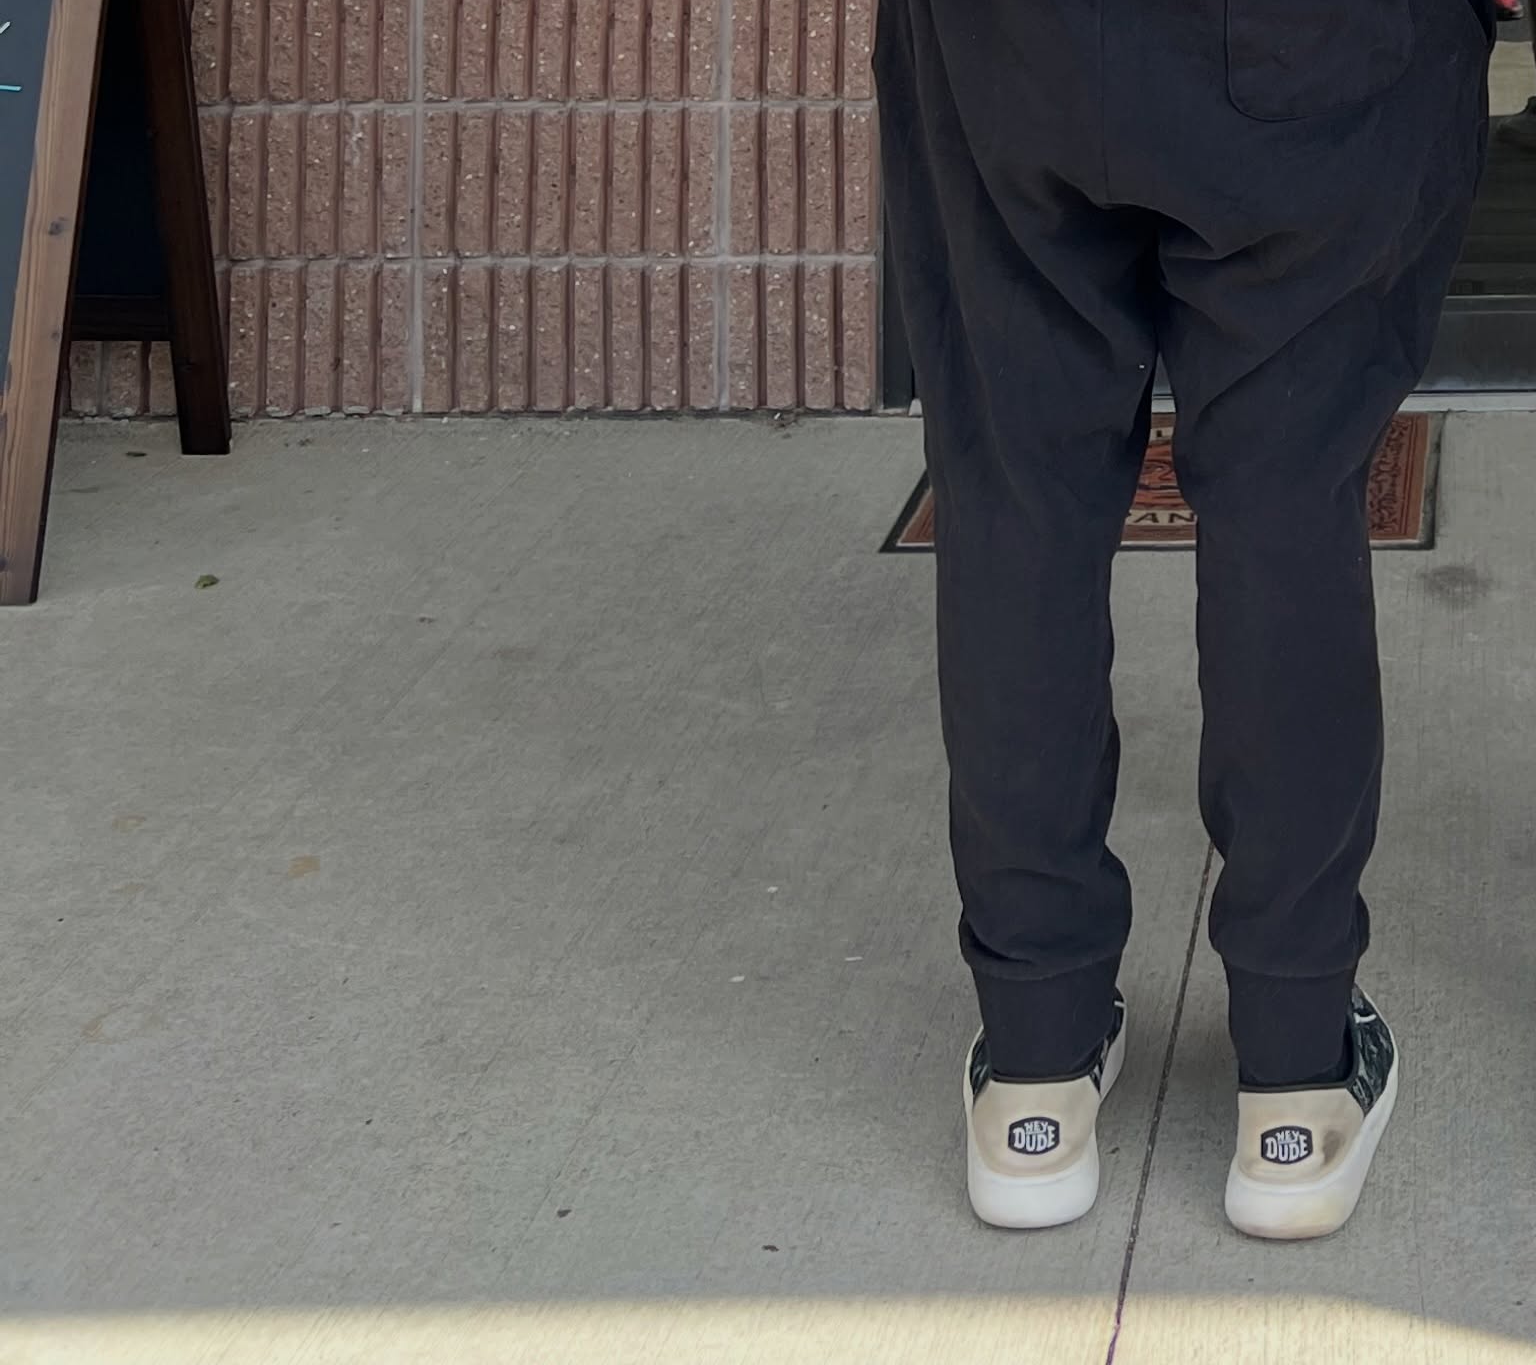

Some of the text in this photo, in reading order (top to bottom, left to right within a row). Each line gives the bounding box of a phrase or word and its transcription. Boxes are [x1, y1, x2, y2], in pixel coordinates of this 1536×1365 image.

[1024, 1120, 1049, 1134] HEY
[1277, 1129, 1300, 1142] HEY
[1012, 1124, 1056, 1152] DUDE
[1265, 1134, 1309, 1162] DUDE
